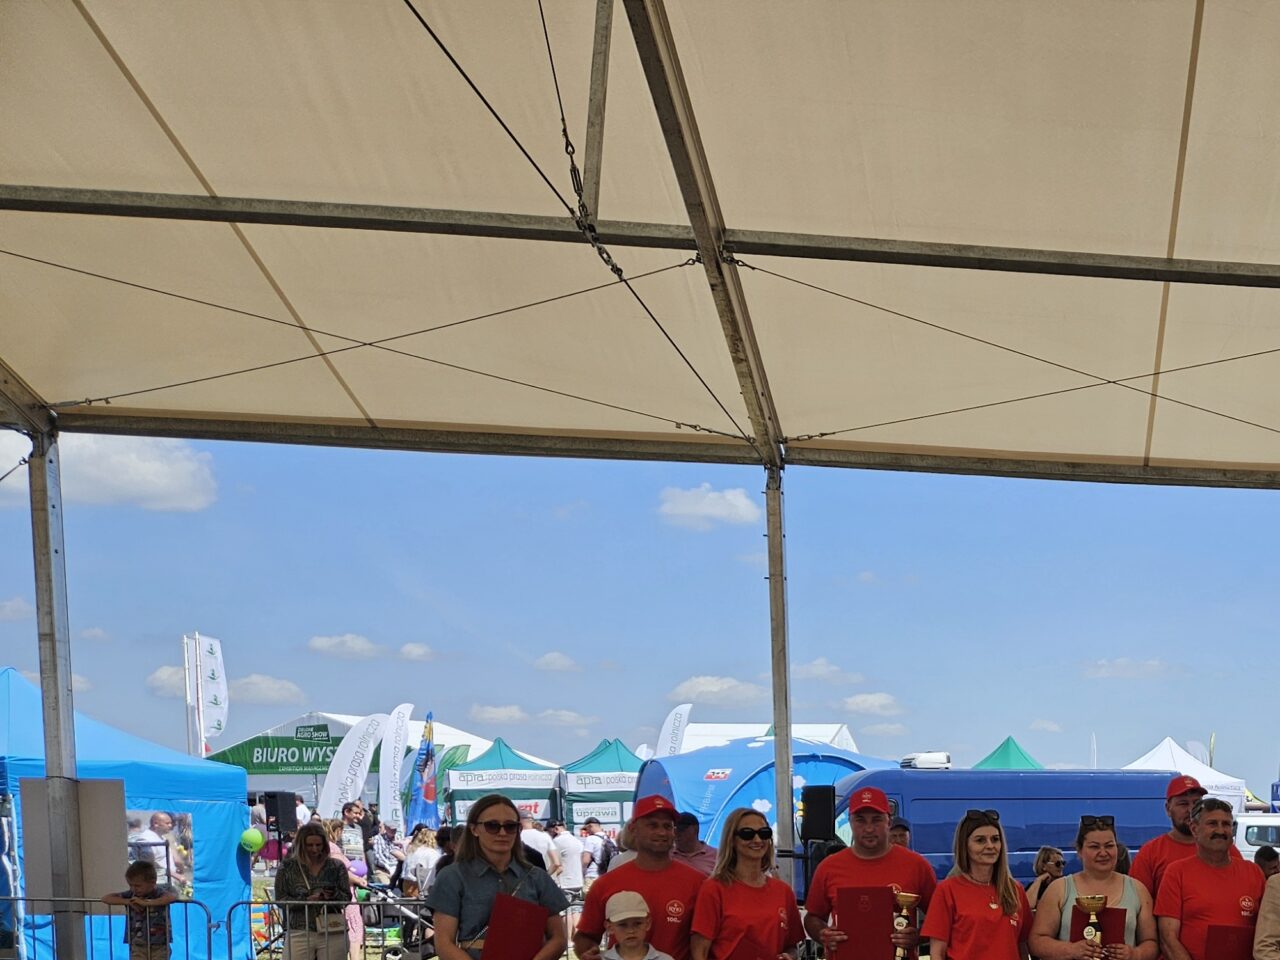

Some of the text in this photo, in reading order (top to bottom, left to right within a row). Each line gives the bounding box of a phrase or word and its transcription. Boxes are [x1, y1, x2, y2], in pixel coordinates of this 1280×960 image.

[253, 747, 299, 763] BIURO
[348, 751, 365, 778] prasa
[358, 719, 380, 753] rolnicza
[459, 773, 484, 786] apra
[576, 775, 602, 789] apra
